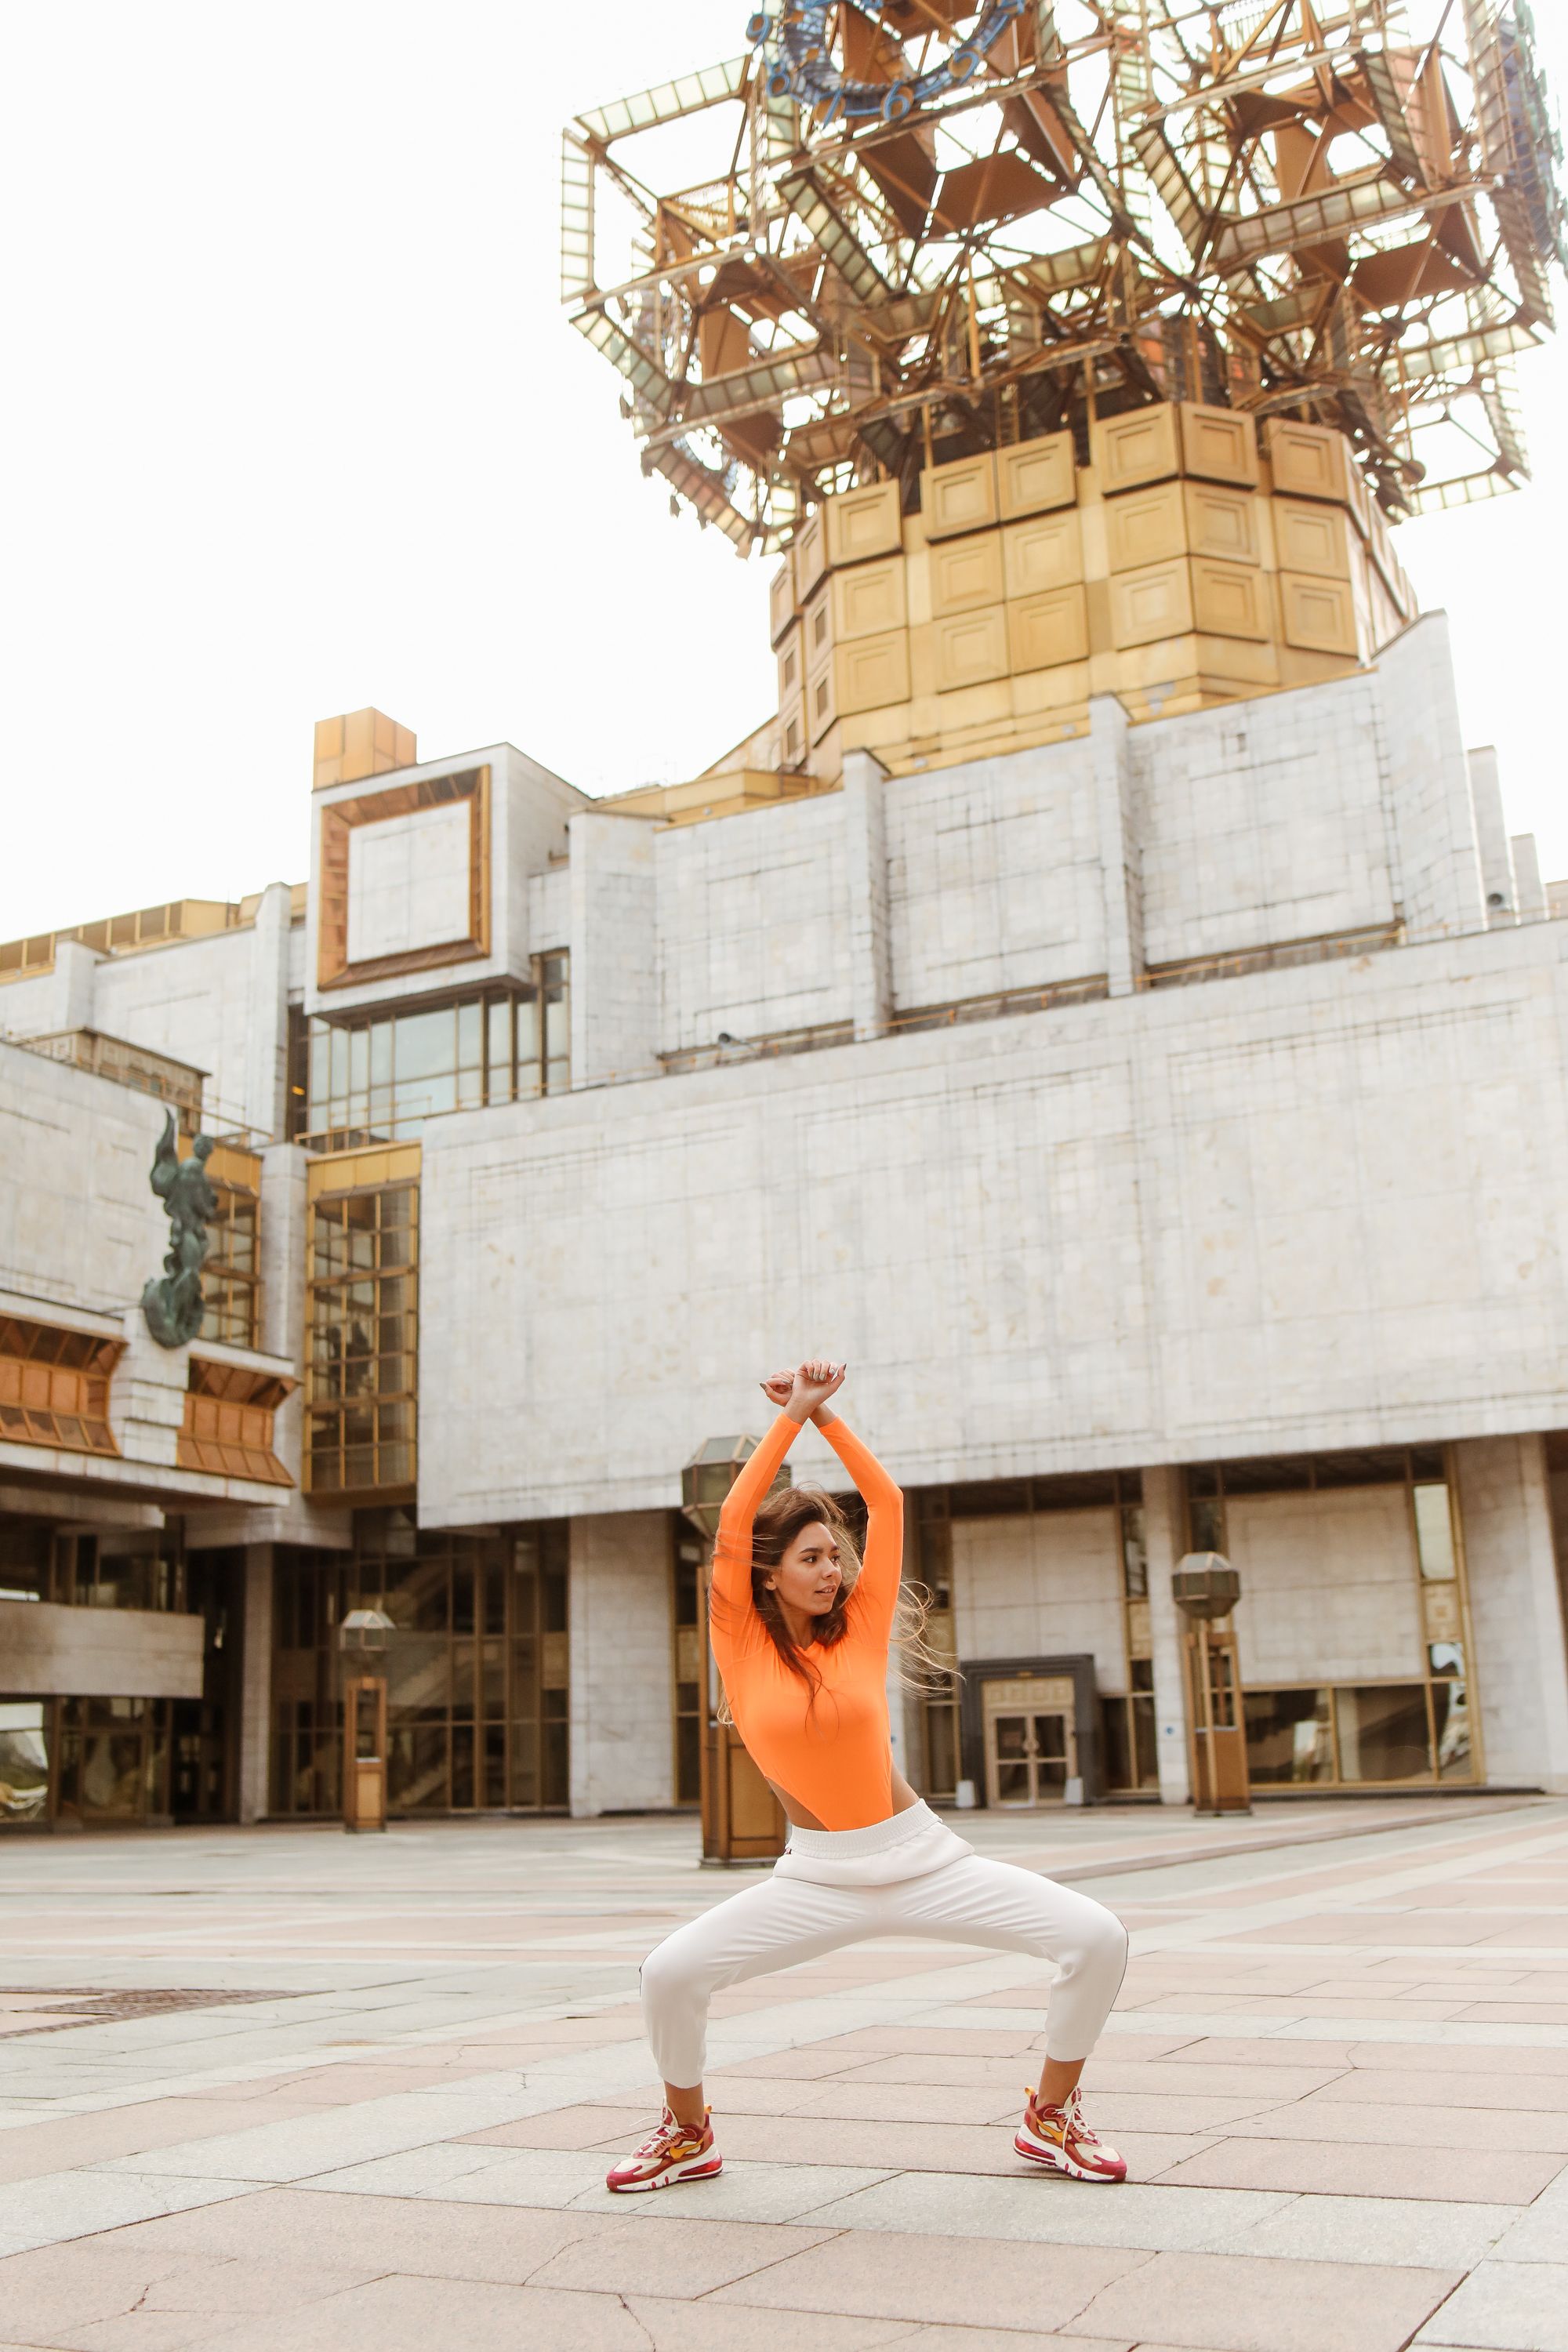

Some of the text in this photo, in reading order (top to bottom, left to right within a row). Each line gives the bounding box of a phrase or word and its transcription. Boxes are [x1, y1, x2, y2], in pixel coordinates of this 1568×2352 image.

[746, 13, 771, 50] 9
[766, 60, 790, 97] 8
[884, 80, 910, 122] 6
